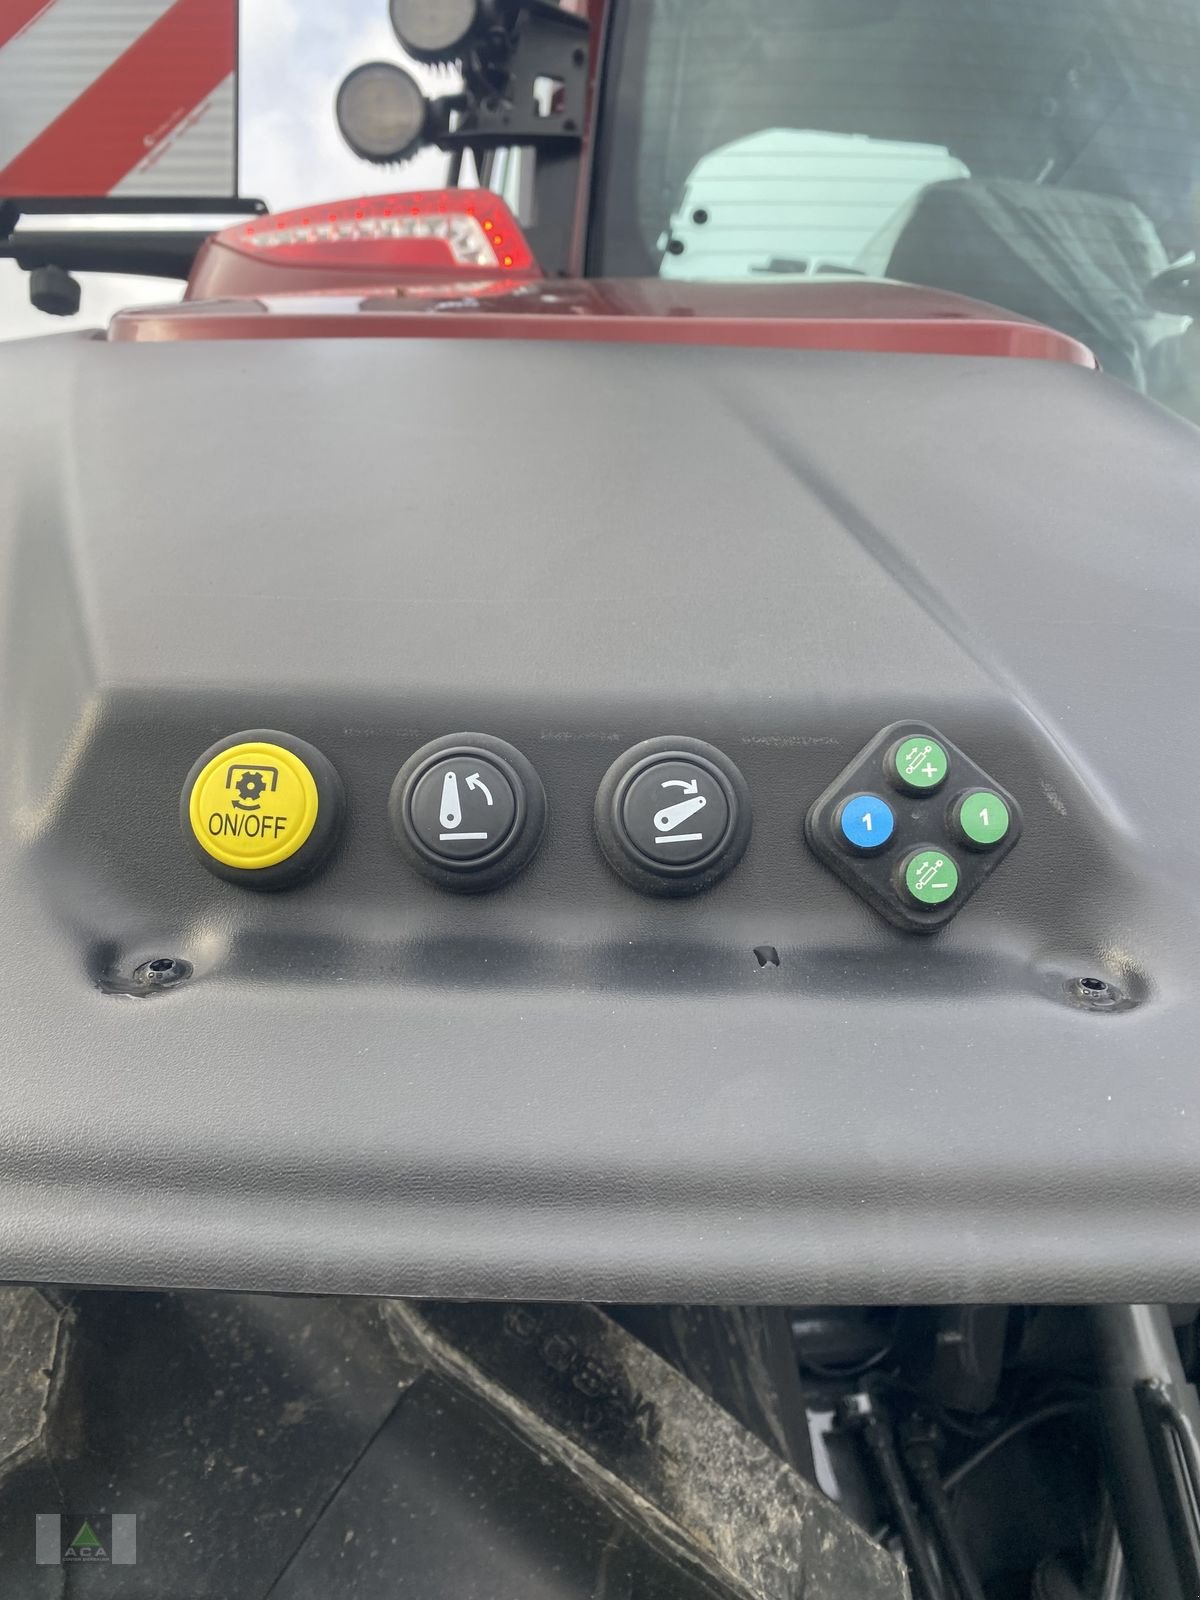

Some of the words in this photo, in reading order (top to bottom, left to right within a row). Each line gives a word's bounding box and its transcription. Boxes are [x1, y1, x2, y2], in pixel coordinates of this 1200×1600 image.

[208, 812, 287, 839] ON/OFF
[862, 812, 872, 831] 1
[979, 807, 989, 826] 1
